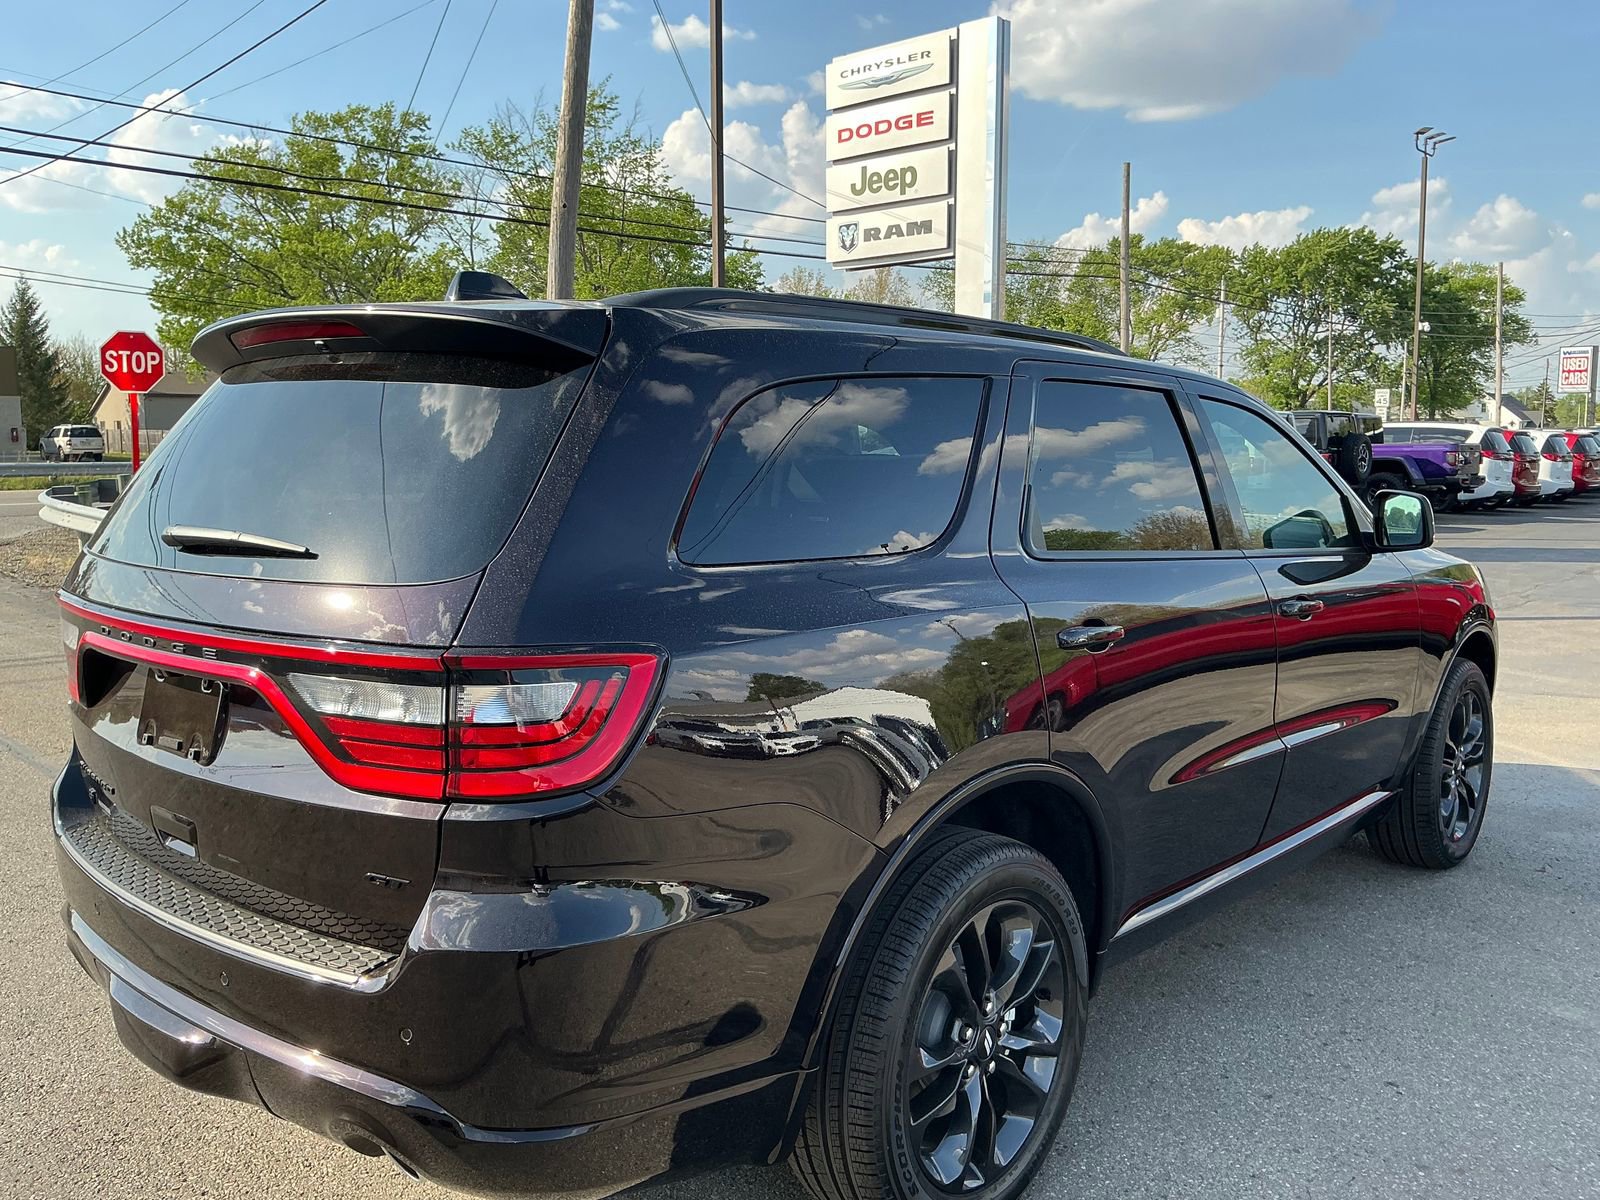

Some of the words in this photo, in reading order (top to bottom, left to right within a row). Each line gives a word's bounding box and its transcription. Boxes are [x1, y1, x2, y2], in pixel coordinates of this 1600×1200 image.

[839, 50, 932, 79] CHRYSLER
[837, 110, 934, 144] DODGE
[850, 165, 917, 196] Jeep
[863, 219, 933, 242] RAM
[104, 350, 160, 374] STOP
[1563, 357, 1588, 371] USED
[1562, 372, 1588, 385] CARS
[1376, 397, 1388, 405] 45
[100, 625, 218, 660] DODGE
[894, 1058, 919, 1198] SCORPION
